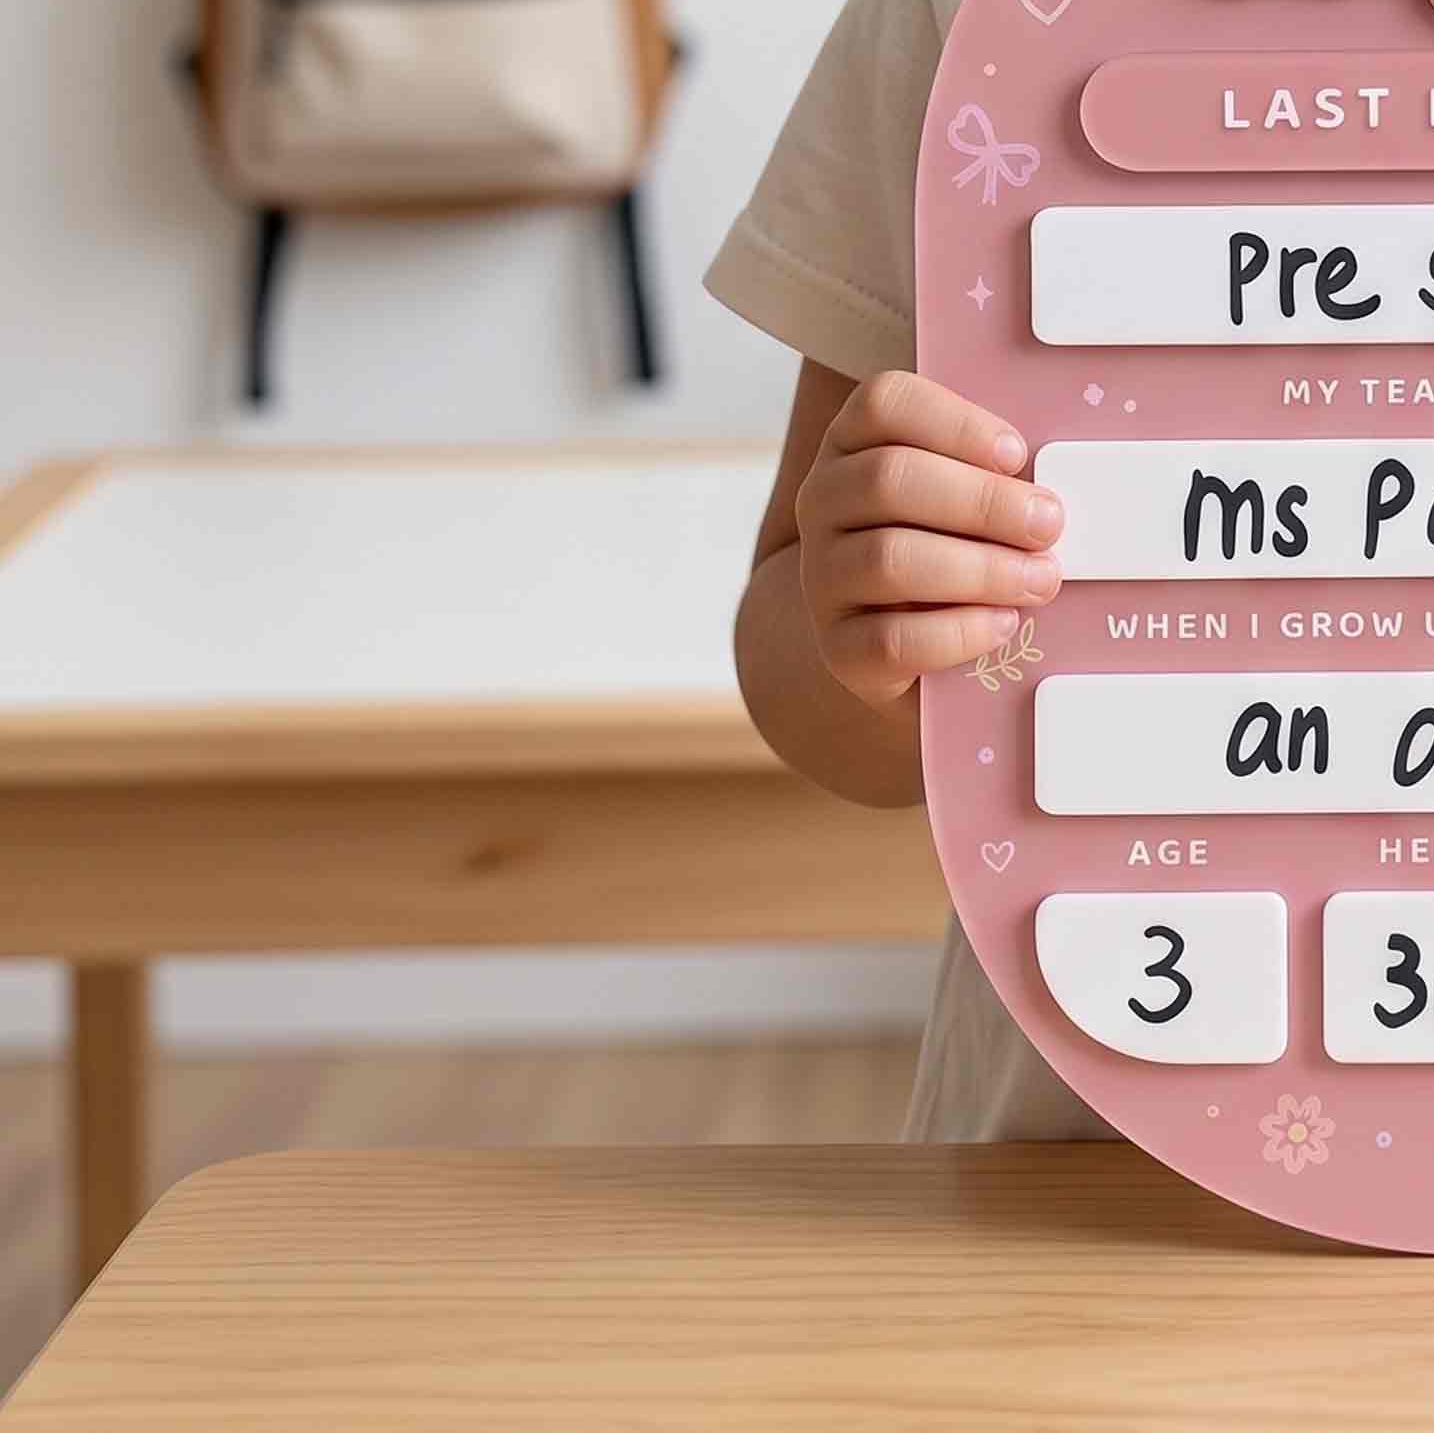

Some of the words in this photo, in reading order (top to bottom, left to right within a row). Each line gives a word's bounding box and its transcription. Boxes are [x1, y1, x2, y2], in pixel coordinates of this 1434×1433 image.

[1223, 86, 1390, 130] LAST
[1282, 379, 1339, 405] MY
[1106, 612, 1228, 640] WHEN
[1250, 612, 1259, 640] I
[1279, 611, 1404, 639] GROW
[1225, 701, 1329, 778] an
[1126, 839, 1208, 866] AGE
[1127, 925, 1193, 1024] 3
